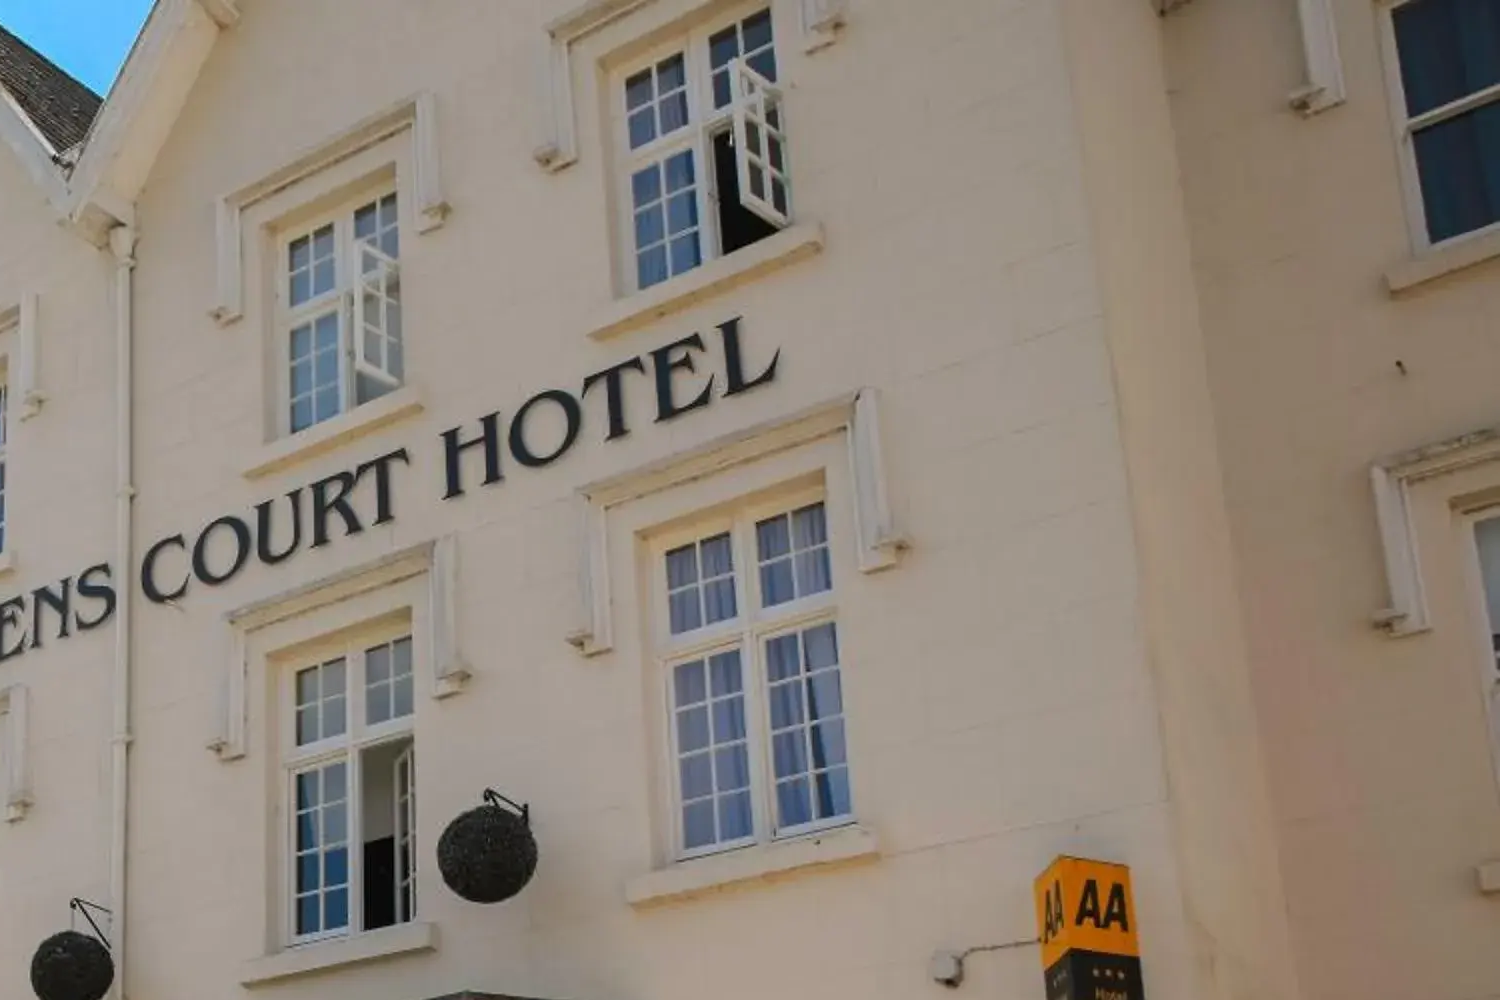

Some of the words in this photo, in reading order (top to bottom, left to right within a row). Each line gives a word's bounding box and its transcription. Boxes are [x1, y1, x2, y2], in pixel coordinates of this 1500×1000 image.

[141, 449, 410, 603] COURT
[439, 316, 781, 500] HOTEL
[1044, 880, 1065, 944] AA
[1075, 879, 1129, 933] AA
